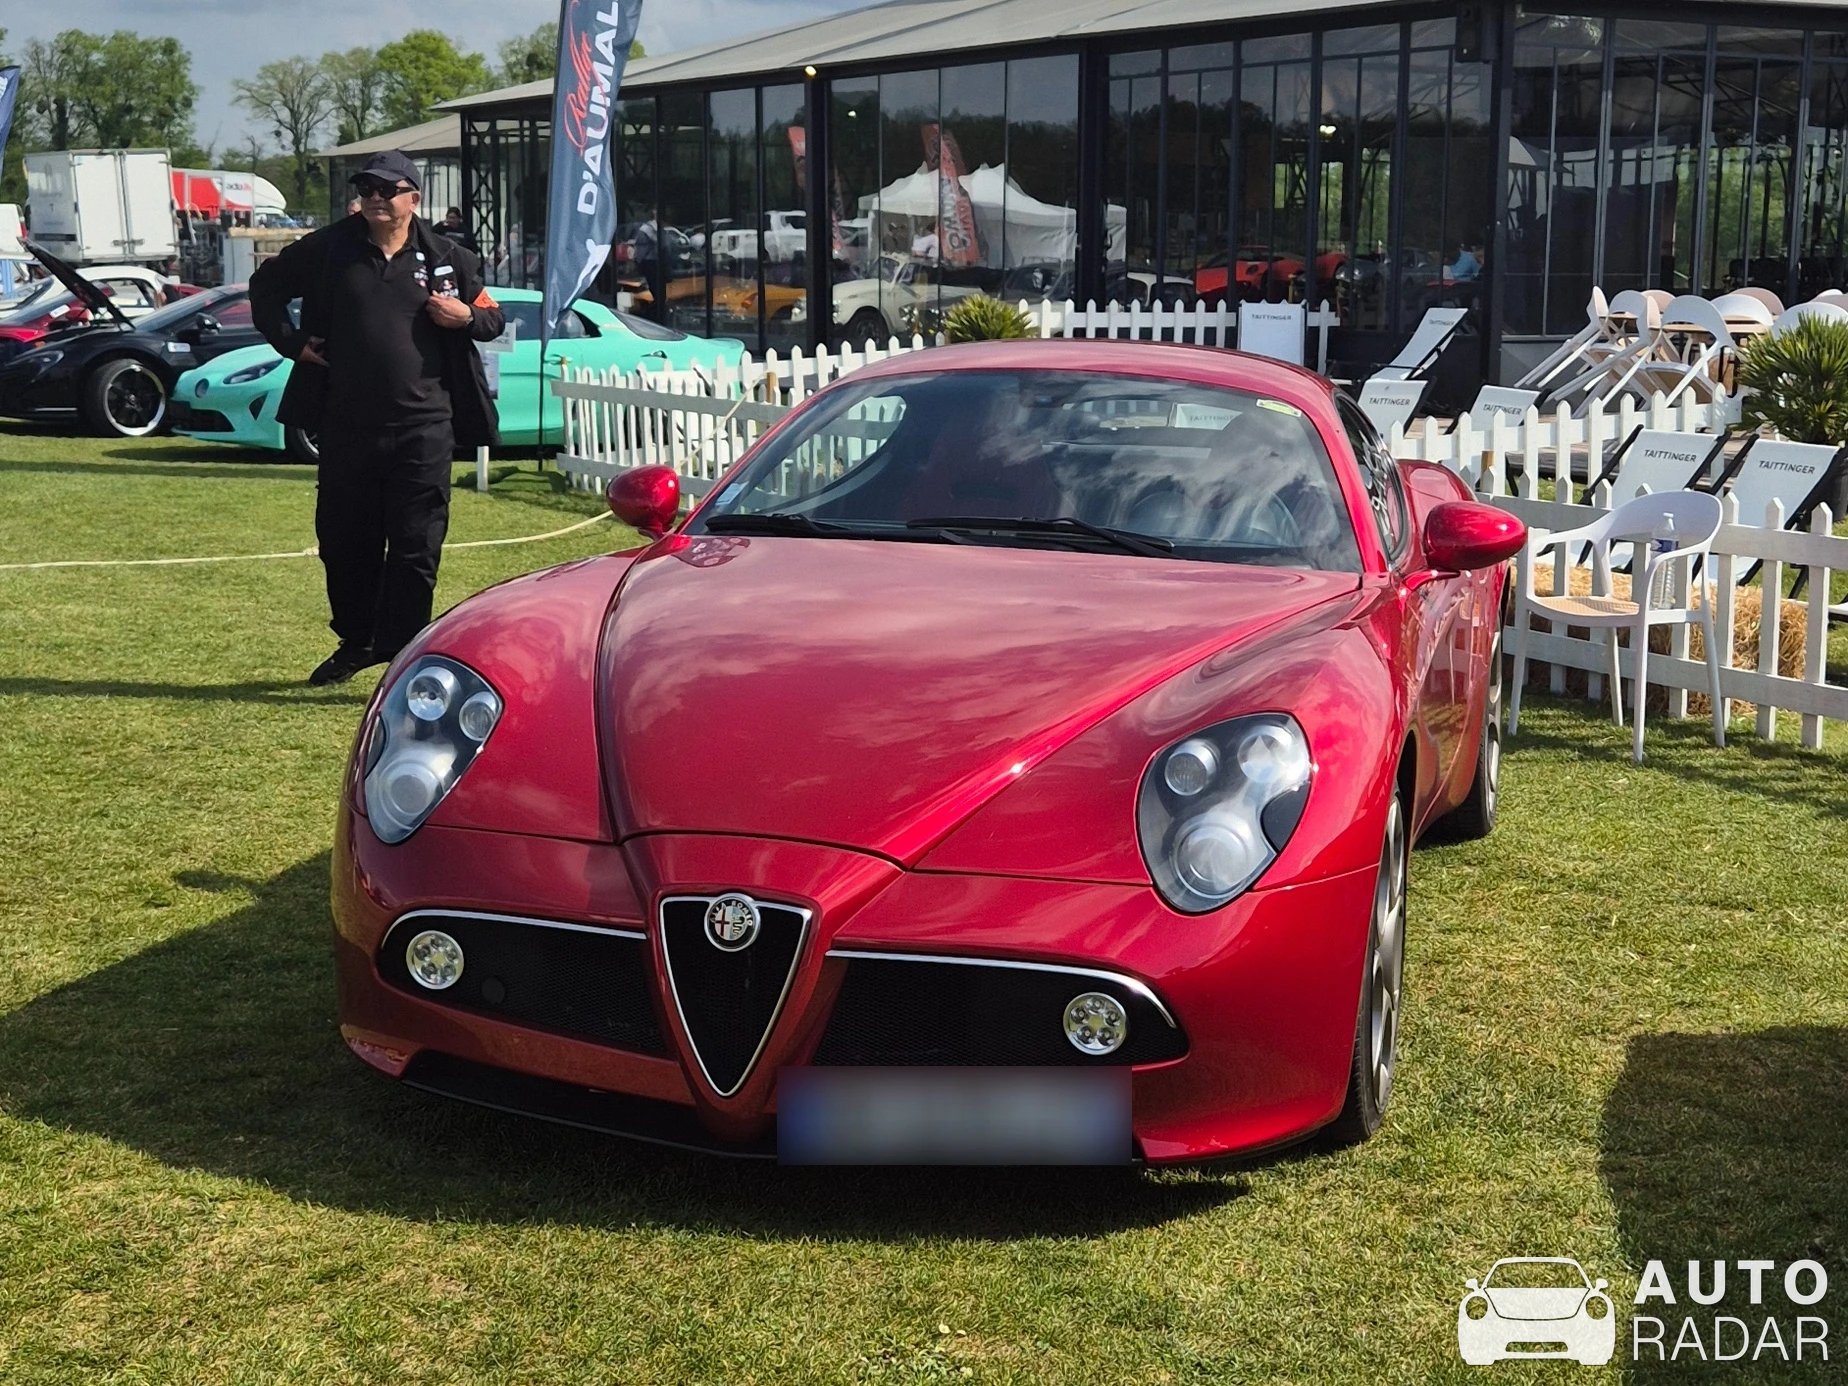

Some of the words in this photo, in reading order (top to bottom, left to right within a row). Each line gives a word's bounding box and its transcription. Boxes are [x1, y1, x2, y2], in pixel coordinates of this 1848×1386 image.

[577, 0, 619, 215] D'AUMAL
[1369, 397, 1411, 406] TAITTINGER
[1643, 449, 1697, 463] TAITTINGER
[1758, 460, 1816, 475] TAITTINGER
[731, 900, 753, 927] ROMEO
